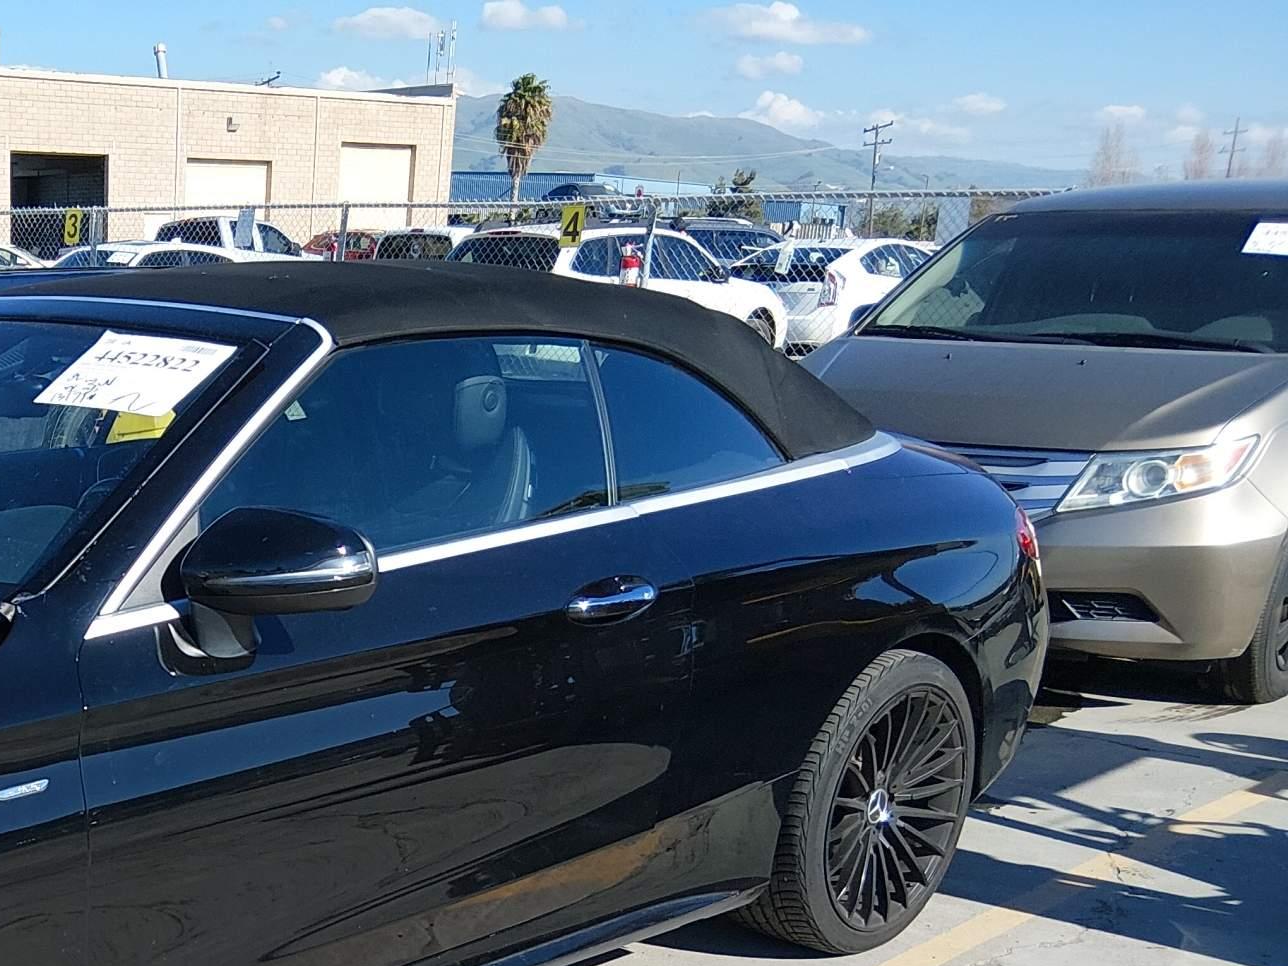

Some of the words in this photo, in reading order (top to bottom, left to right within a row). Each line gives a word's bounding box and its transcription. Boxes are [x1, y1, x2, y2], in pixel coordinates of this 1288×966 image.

[67, 213, 78, 239] 3
[562, 211, 580, 242] 4
[94, 350, 201, 372] 44522822
